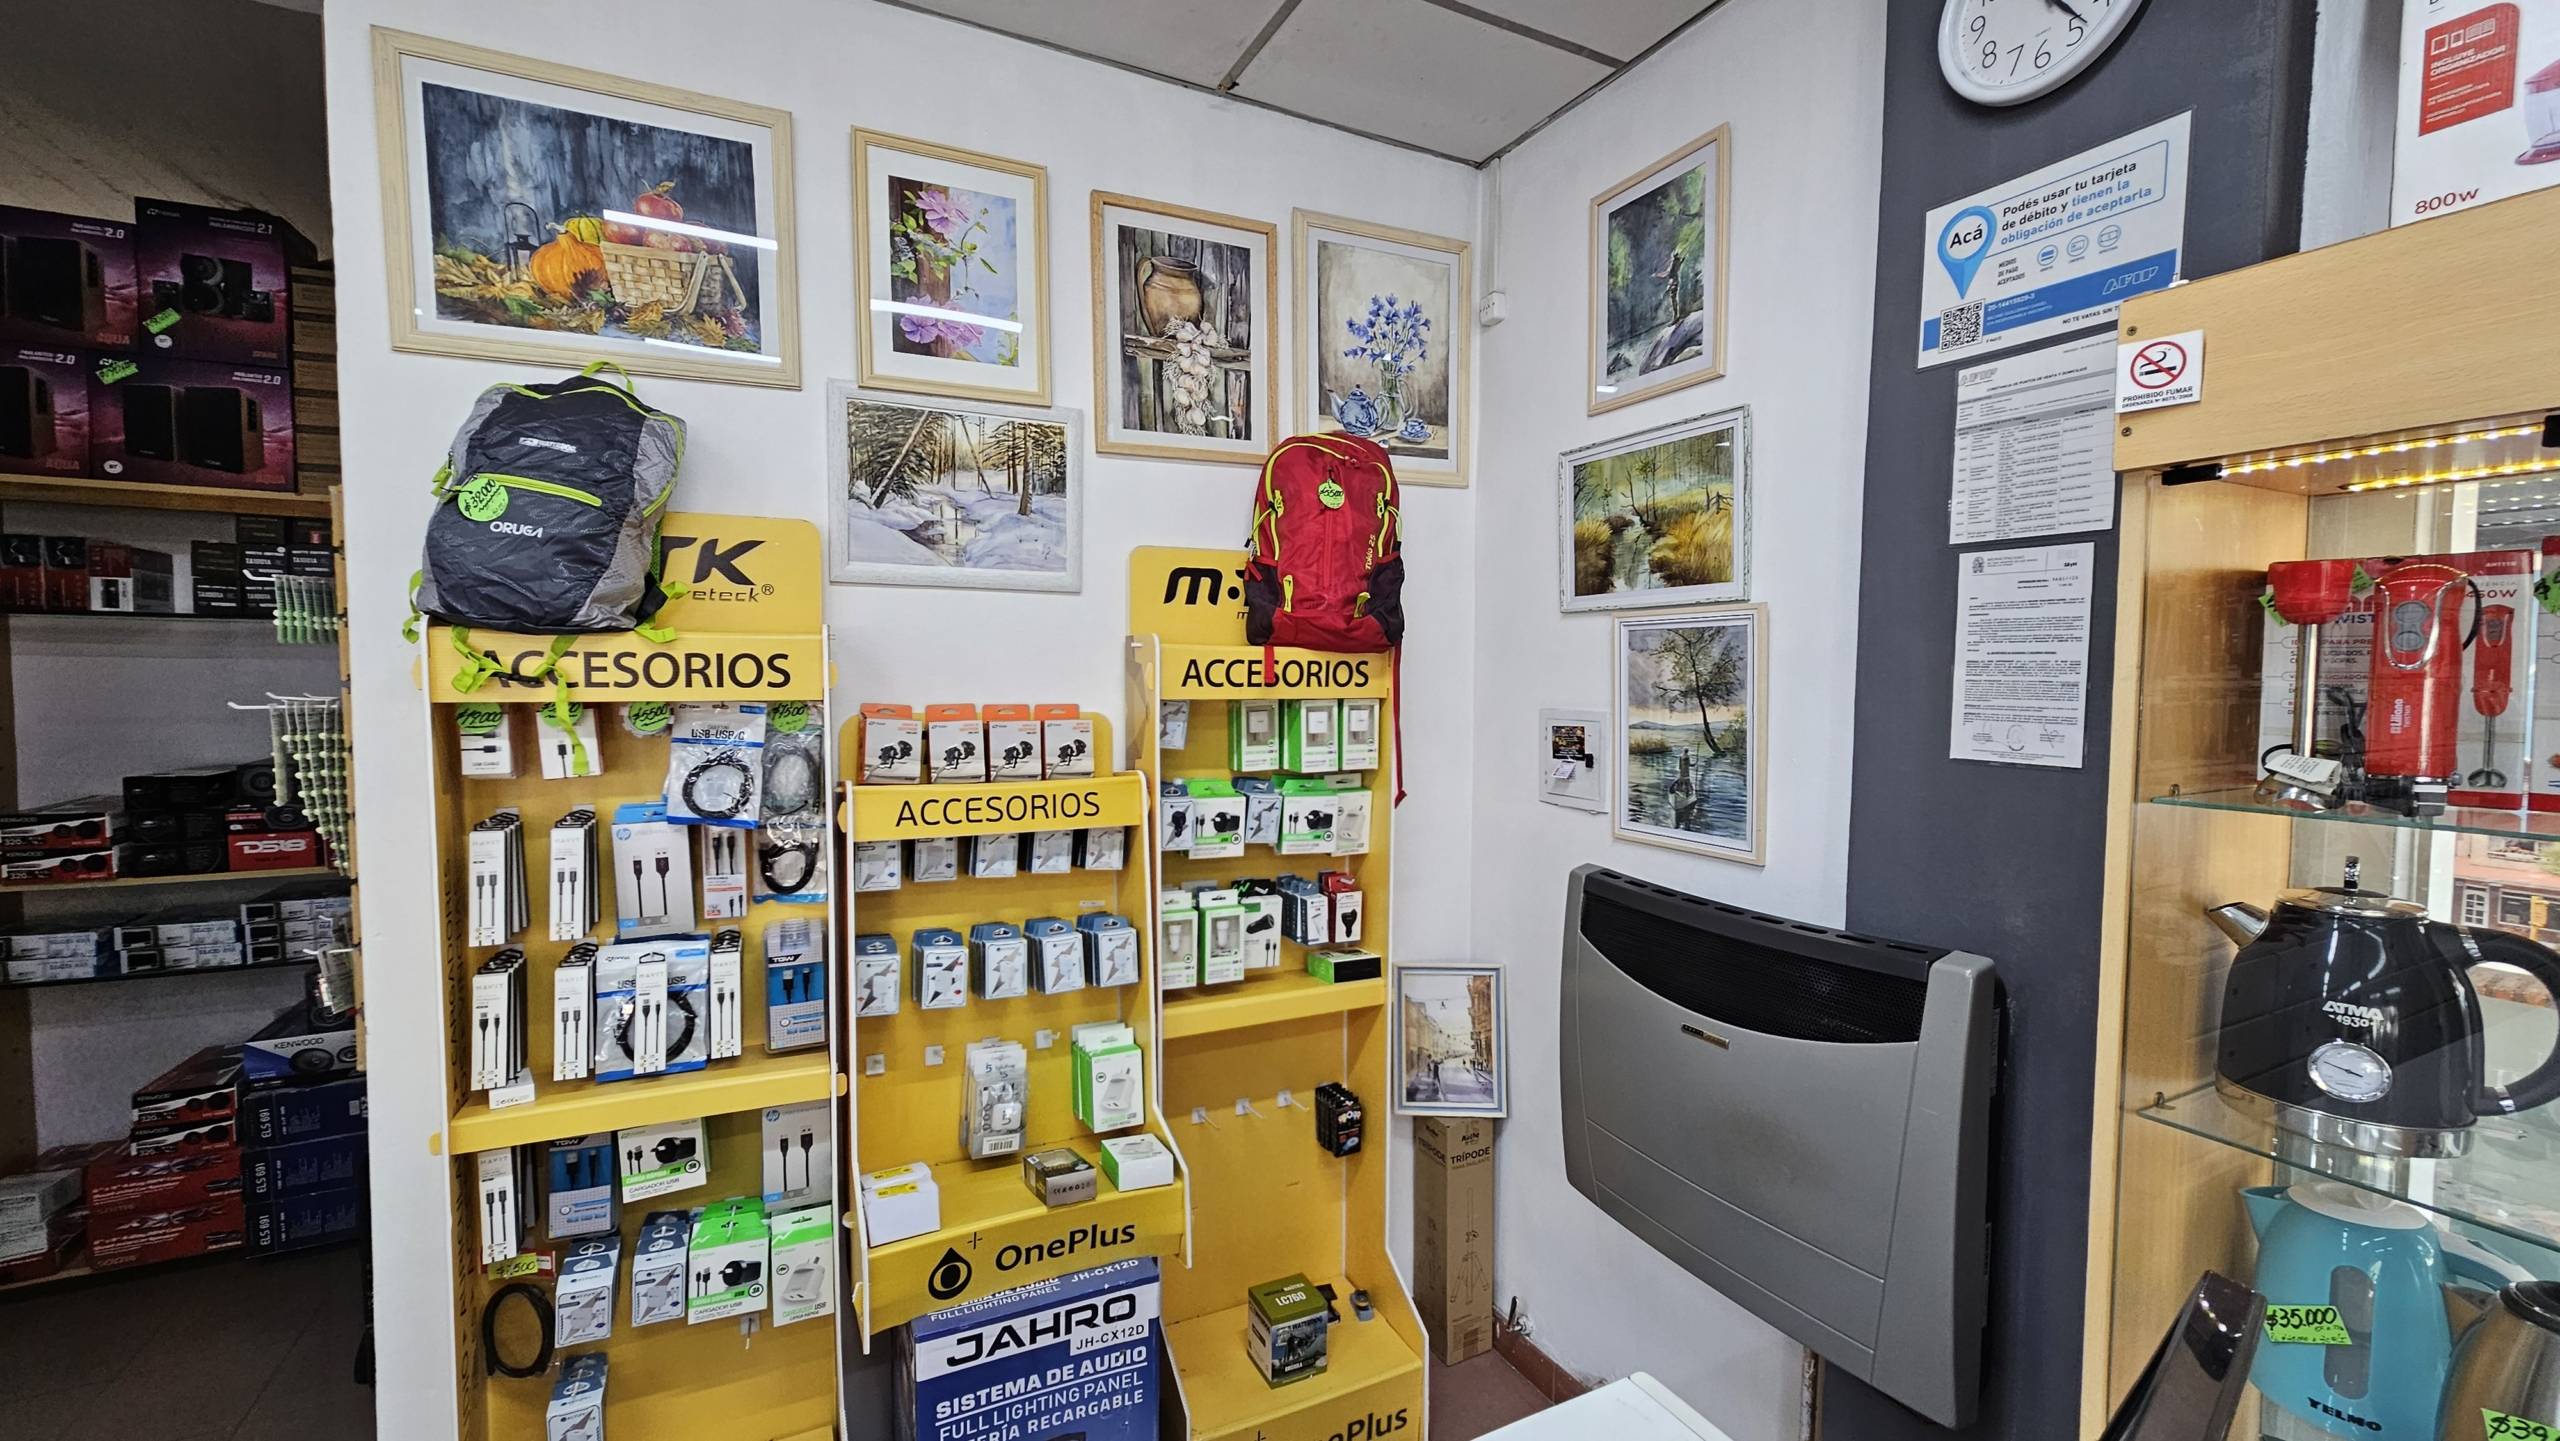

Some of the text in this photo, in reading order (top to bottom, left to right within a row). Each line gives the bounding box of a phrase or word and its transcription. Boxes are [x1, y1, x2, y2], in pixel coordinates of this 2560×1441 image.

[1970, 15, 1986, 45] 9
[2066, 14, 2088, 47] 5
[1981, 40, 1997, 69] 8
[2006, 44, 2025, 77] 7
[2034, 39, 2051, 69] 6
[2003, 161, 2137, 218] Podés usar tu tarjeta
[2001, 178, 2130, 232] de débito y tienen la
[2001, 186, 2152, 247] obligación de aceptarla
[1949, 224, 1983, 249] Acá
[2102, 266, 2158, 295] AFIP
[55, 353, 76, 365] 2.0
[263, 373, 281, 385] 2.0
[2122, 386, 2193, 403] PROHIBIDO FUMAR
[490, 521, 544, 538] ORUGA
[1181, 658, 1369, 688] ACCESORIOS
[895, 791, 1101, 828] ACCESORIOS
[2322, 1000, 2385, 1020] ATMA
[274, 1037, 325, 1050] KENWOOD
[1450, 1146, 1491, 1165] TRÍPODE
[995, 1223, 1136, 1271] OnePlus
[1071, 1259, 1139, 1283] JH-CX12D
[930, 1284, 1061, 1322] FULL LIGHTING PANEL
[946, 1292, 1138, 1367] JAHRO
[2266, 1307, 2338, 1331] $35.000
[1075, 1324, 1146, 1350] JH-CX12D
[936, 1345, 1147, 1421] SISTEMA DE AUDIO
[940, 1371, 1144, 1441] FULL LIGHTING PANEL
[1027, 1390, 1144, 1433] RECARGABLE
[2308, 1397, 2383, 1431] YELMO
